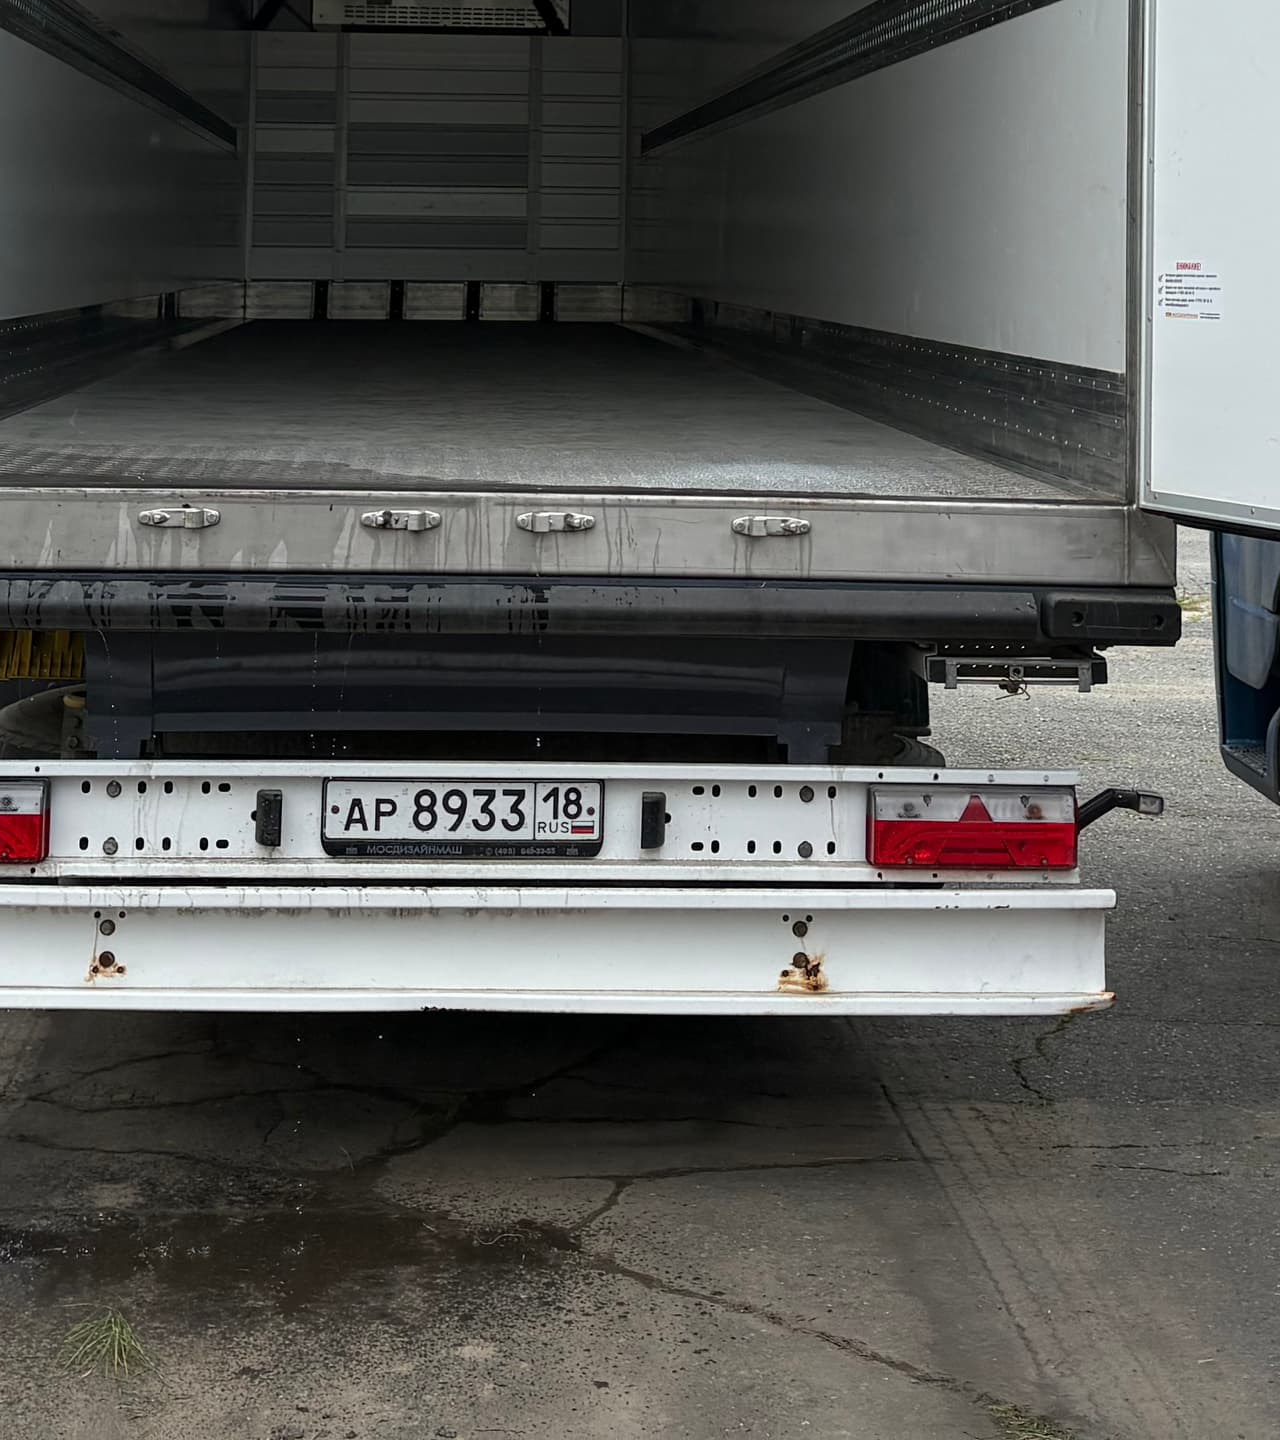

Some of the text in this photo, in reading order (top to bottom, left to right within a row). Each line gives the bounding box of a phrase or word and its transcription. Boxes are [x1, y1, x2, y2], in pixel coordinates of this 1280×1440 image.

[412, 789, 526, 832] 8933
[542, 787, 583, 820] 18
[537, 822, 570, 834] RUS
[367, 844, 463, 855] МОСДИЗАЙНМАШ
